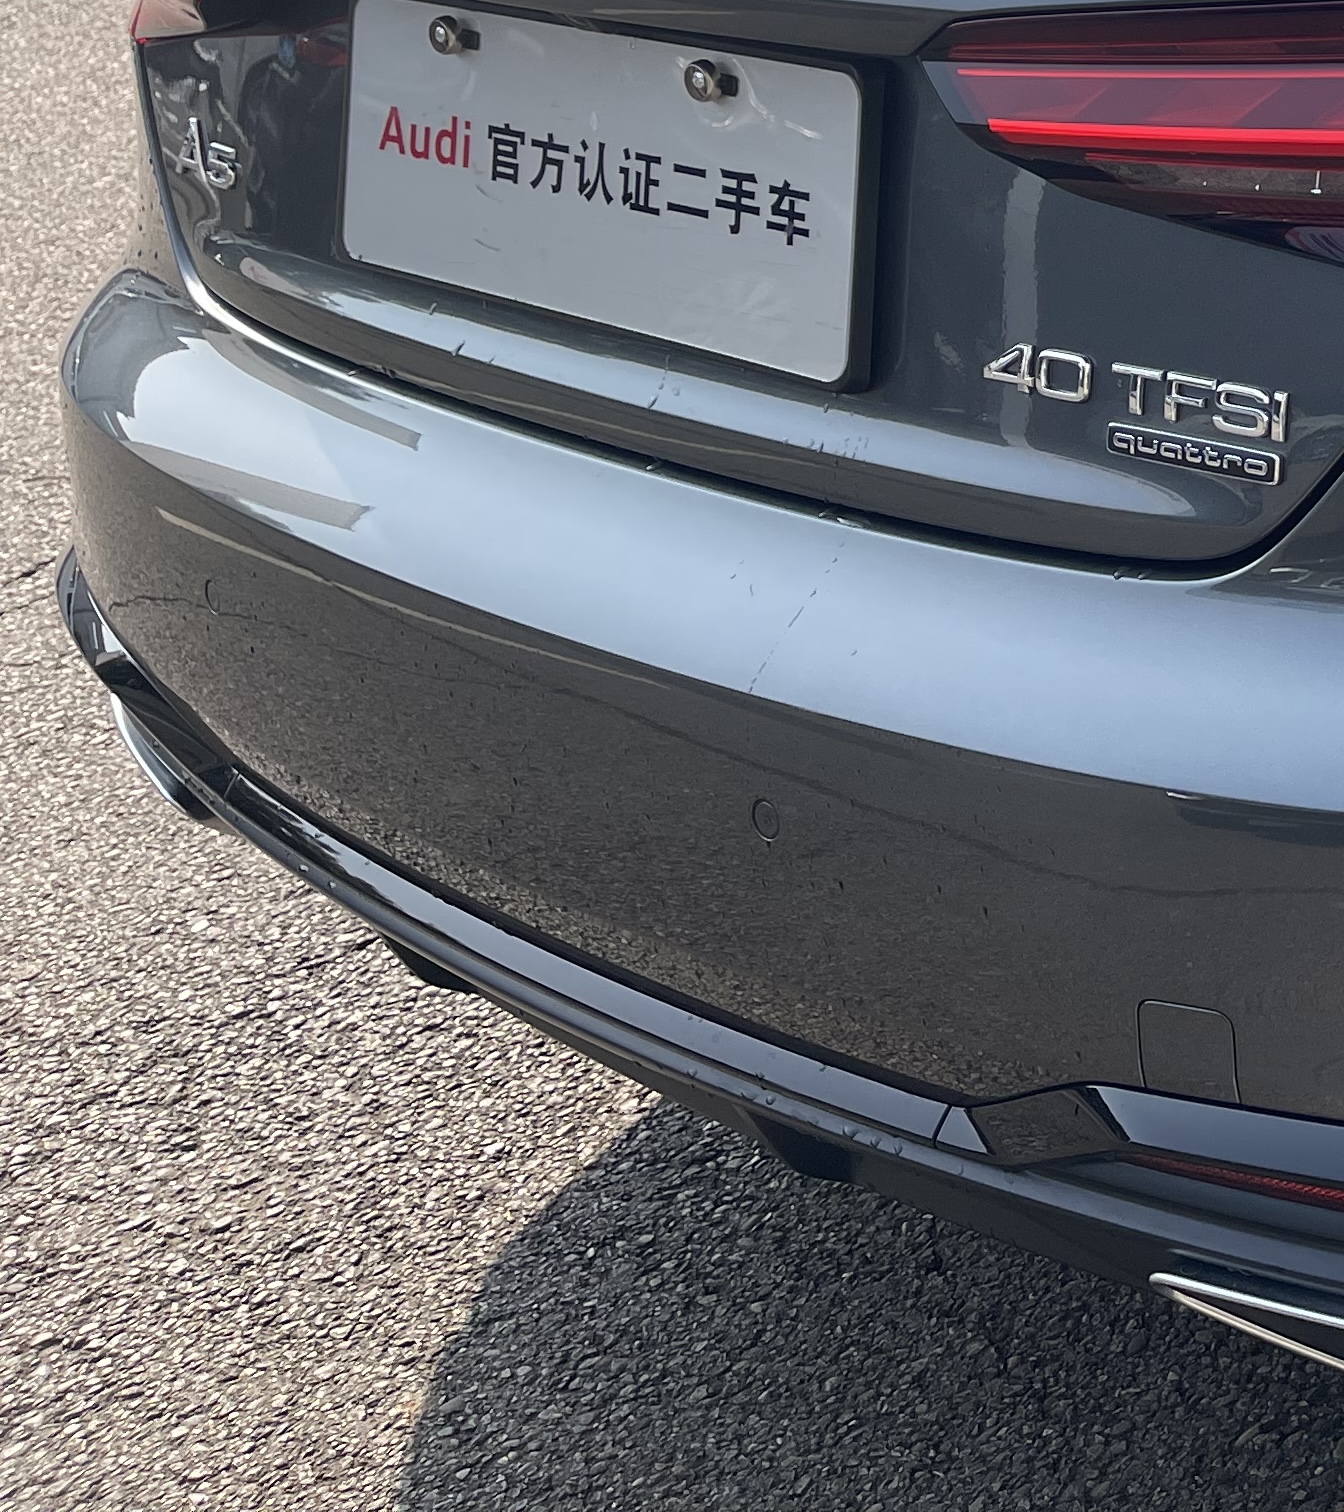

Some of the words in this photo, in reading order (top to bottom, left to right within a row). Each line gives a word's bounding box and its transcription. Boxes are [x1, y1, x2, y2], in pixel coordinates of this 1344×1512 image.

[175, 117, 237, 190] A5
[378, 105, 472, 168] Audi
[486, 123, 811, 246] 官方认证二手车
[983, 342, 1094, 403] 40
[1111, 361, 1290, 443] TFSI
[1113, 431, 1269, 478] quattro
